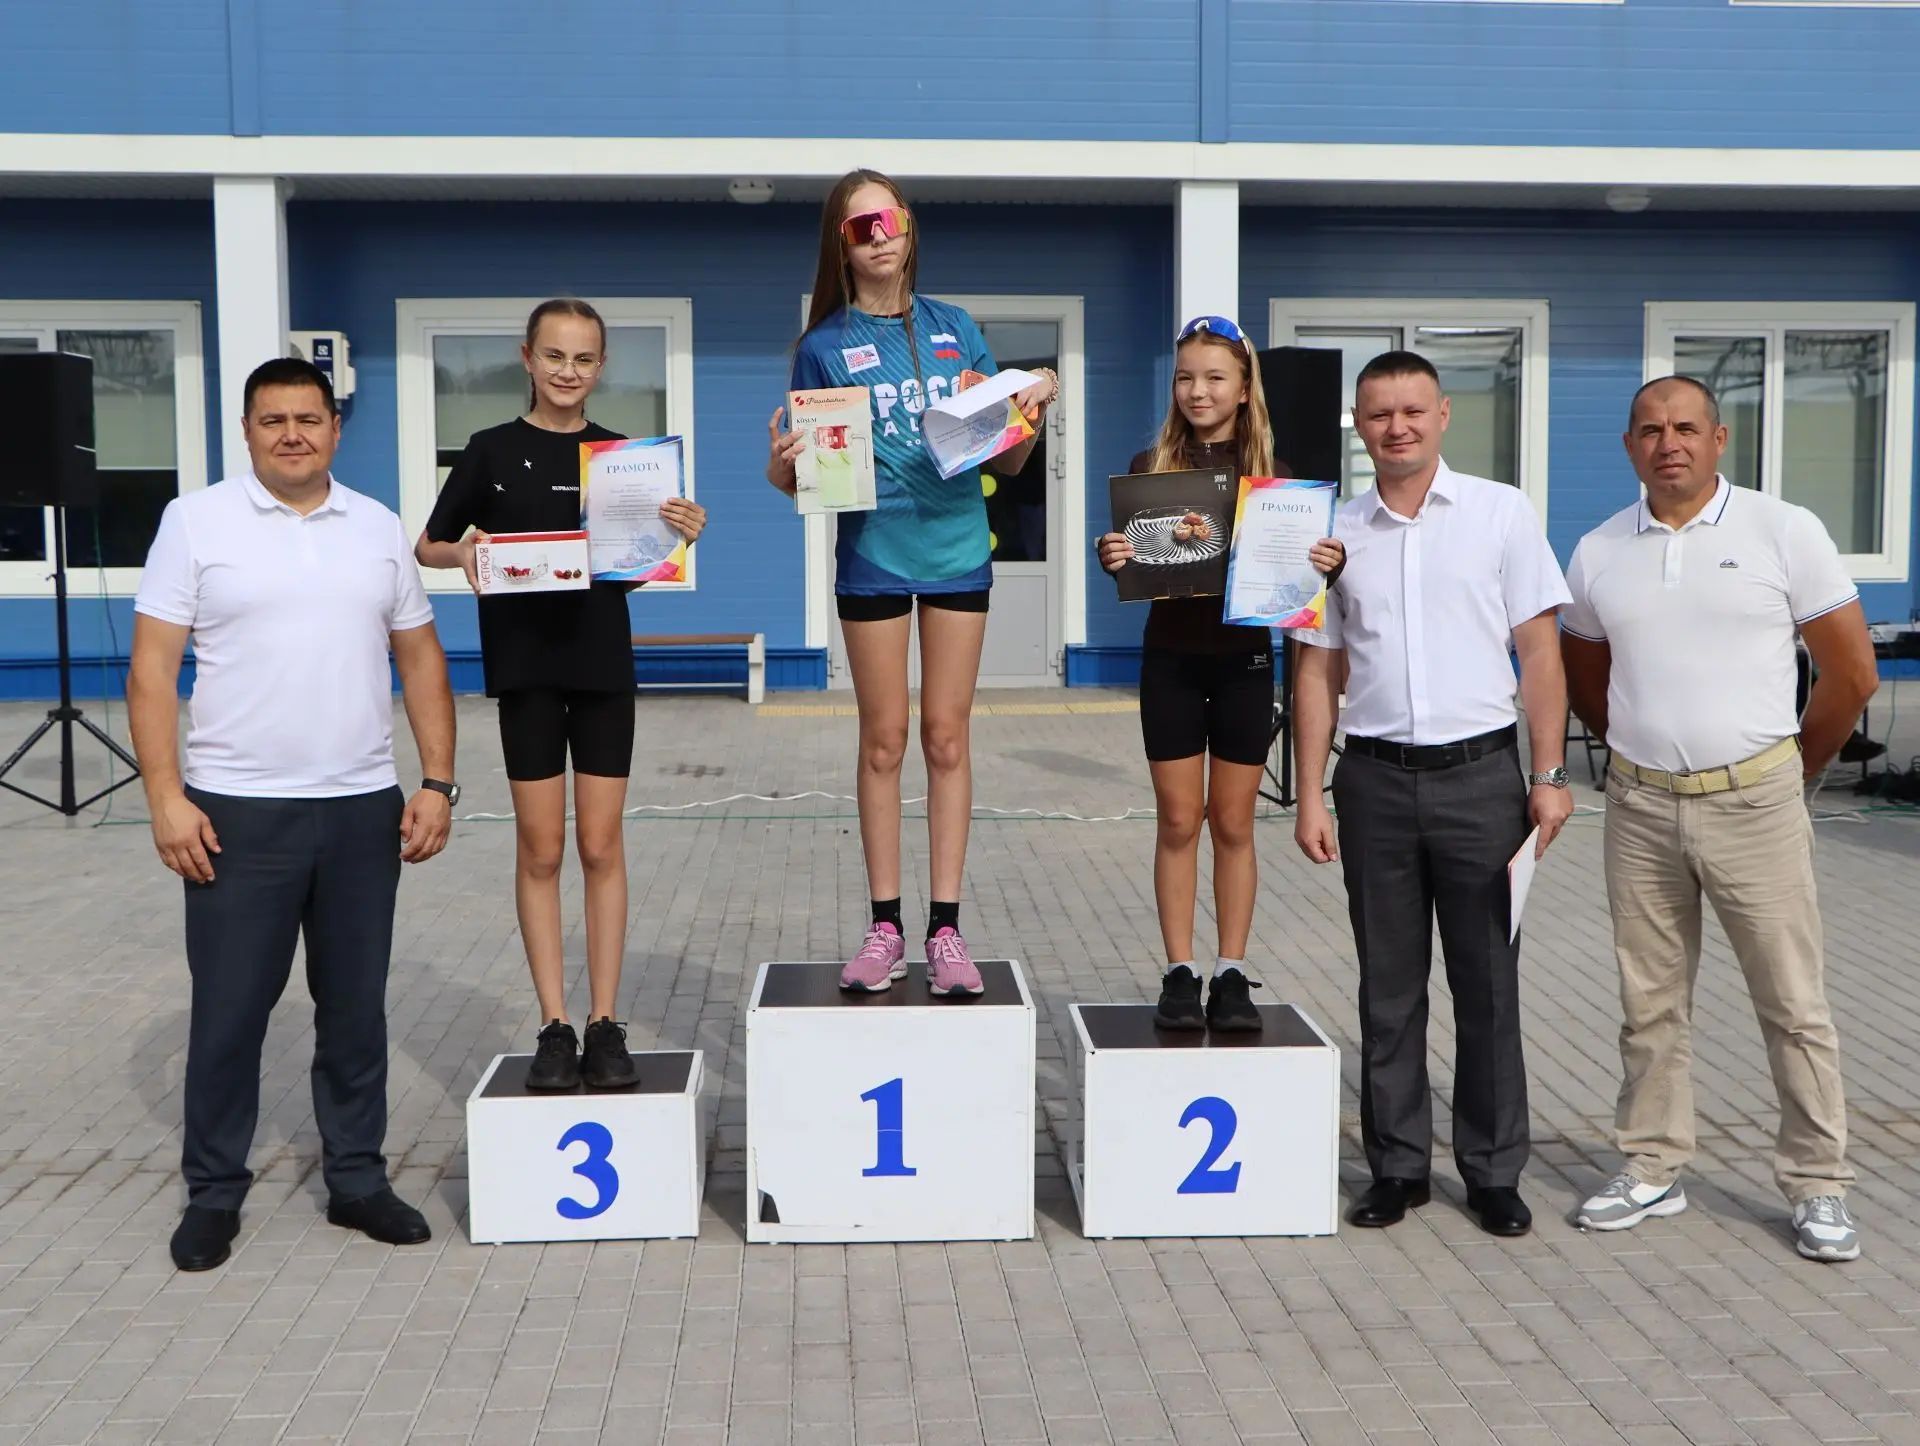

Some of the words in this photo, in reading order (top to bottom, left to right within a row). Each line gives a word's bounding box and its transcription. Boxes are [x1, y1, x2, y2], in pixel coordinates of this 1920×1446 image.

[607, 462, 661, 474] ГРАМОТА
[1261, 502, 1313, 514] ГРАМОТА
[557, 1122, 618, 1219] 3
[862, 1079, 916, 1176] 1
[1178, 1097, 1240, 1193] 2
